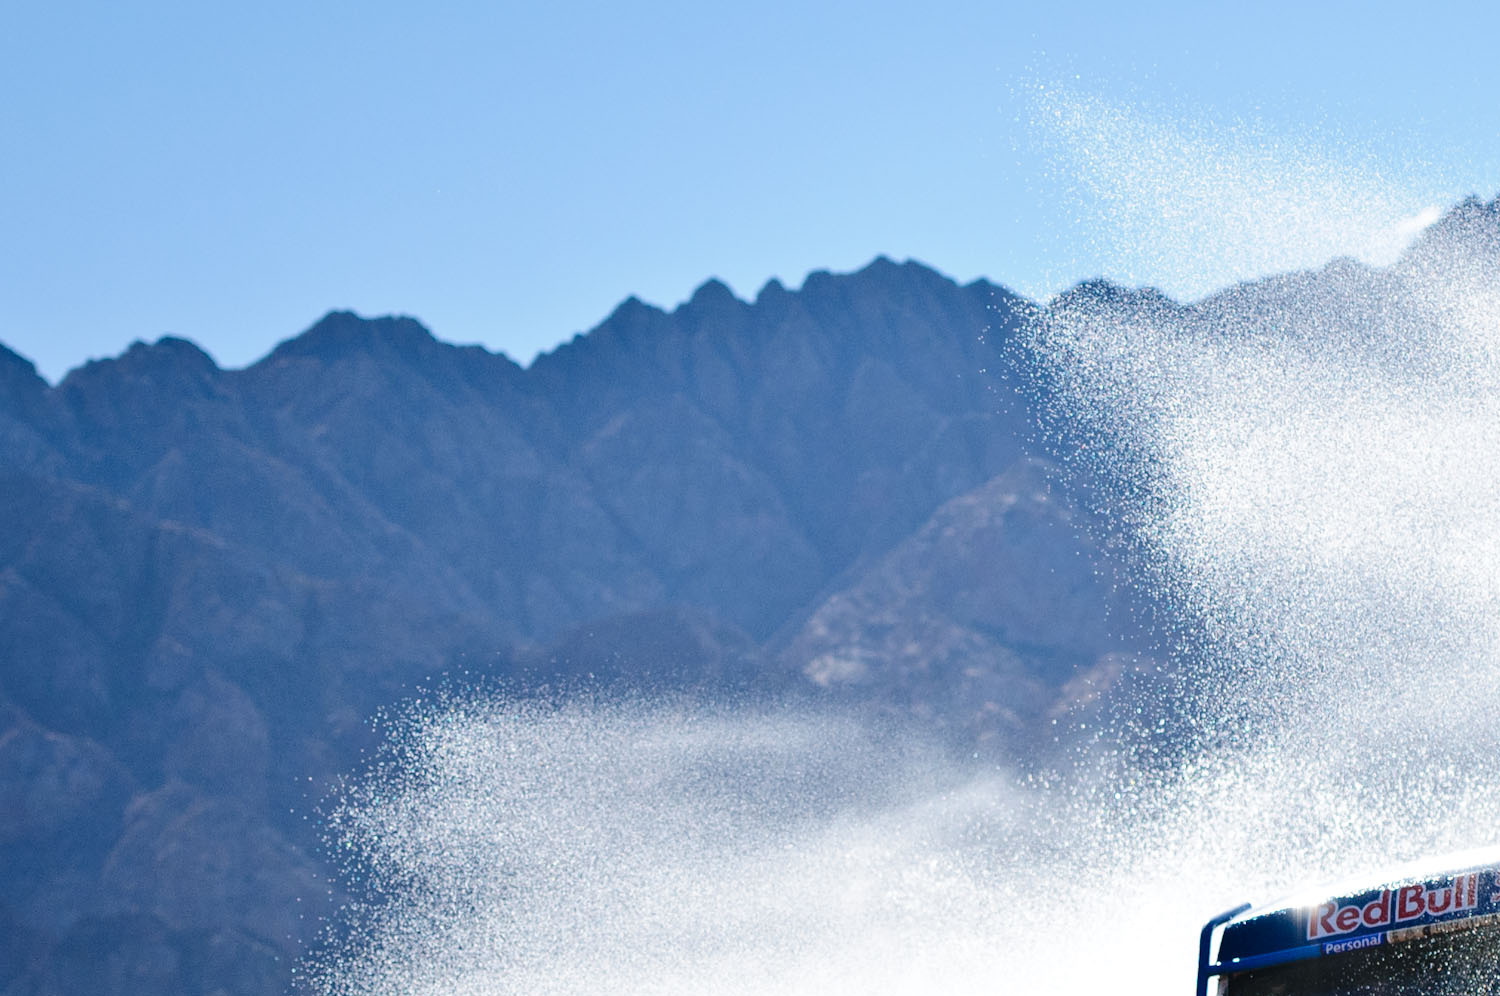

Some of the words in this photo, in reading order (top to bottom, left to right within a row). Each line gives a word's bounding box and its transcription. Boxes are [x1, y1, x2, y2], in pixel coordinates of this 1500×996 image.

[1307, 888, 1391, 940] Red
[1395, 872, 1478, 922] Bull
[1326, 932, 1382, 955] Personal
